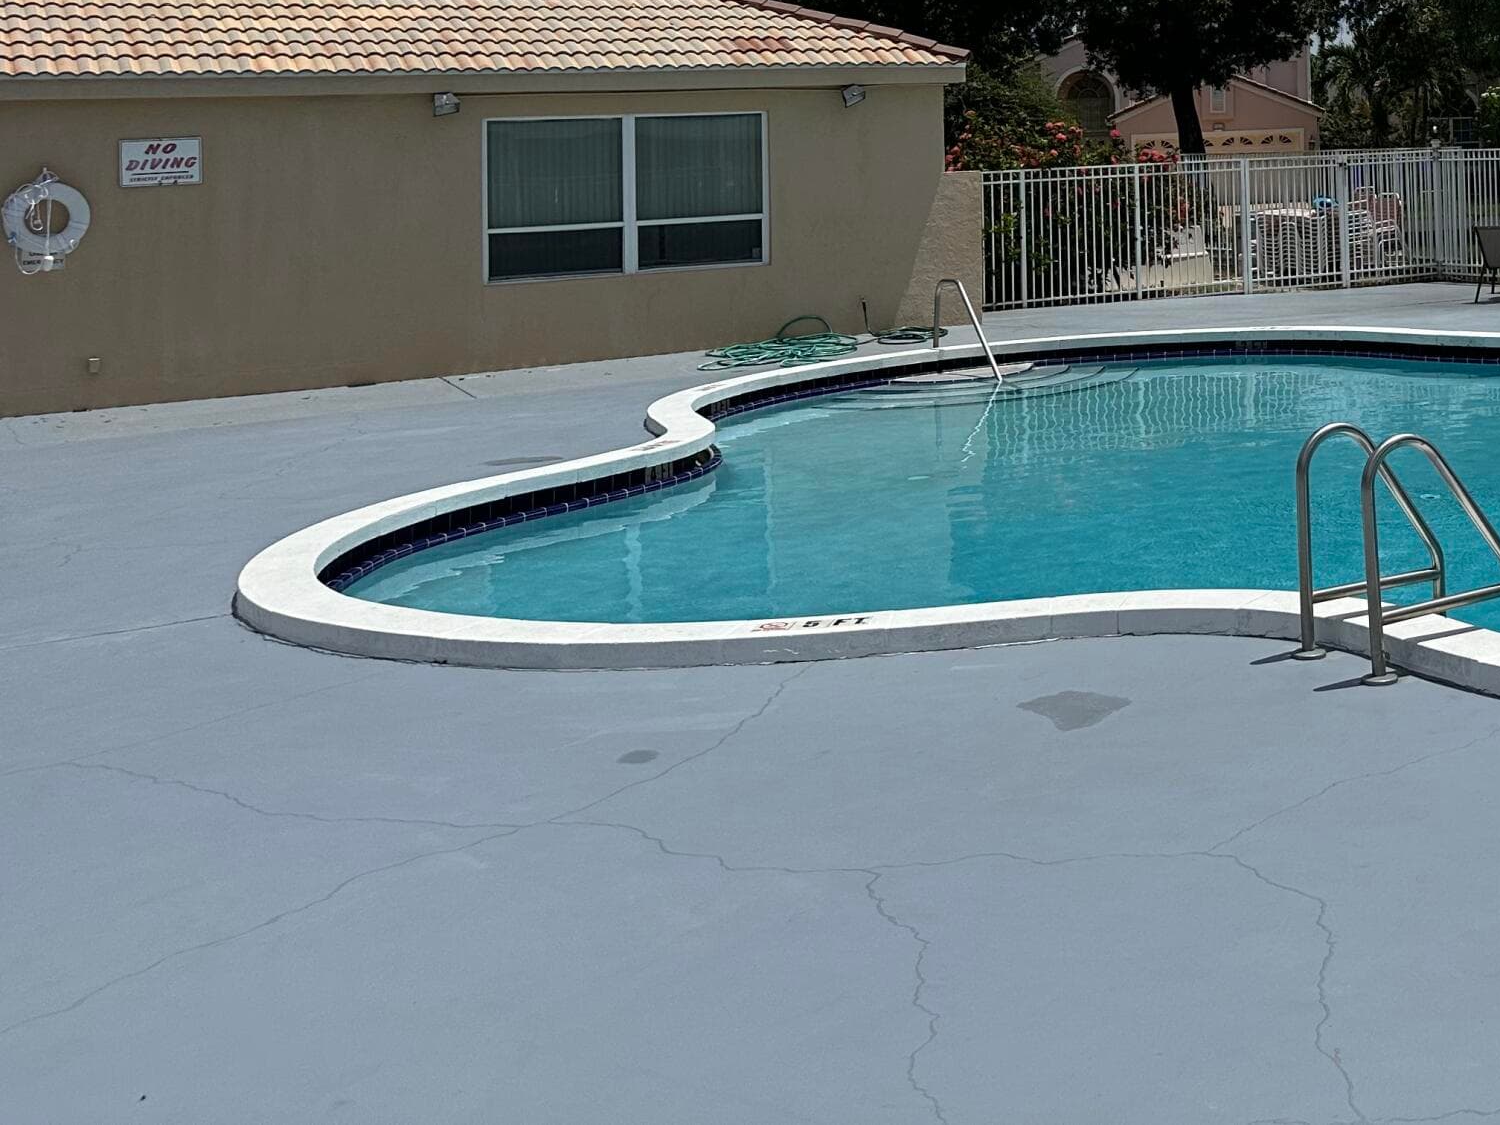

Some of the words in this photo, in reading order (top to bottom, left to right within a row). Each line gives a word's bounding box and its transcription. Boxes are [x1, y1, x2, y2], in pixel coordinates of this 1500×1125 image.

[144, 142, 177, 155] NO
[125, 156, 198, 171] DIVING
[802, 620, 821, 628] 5
